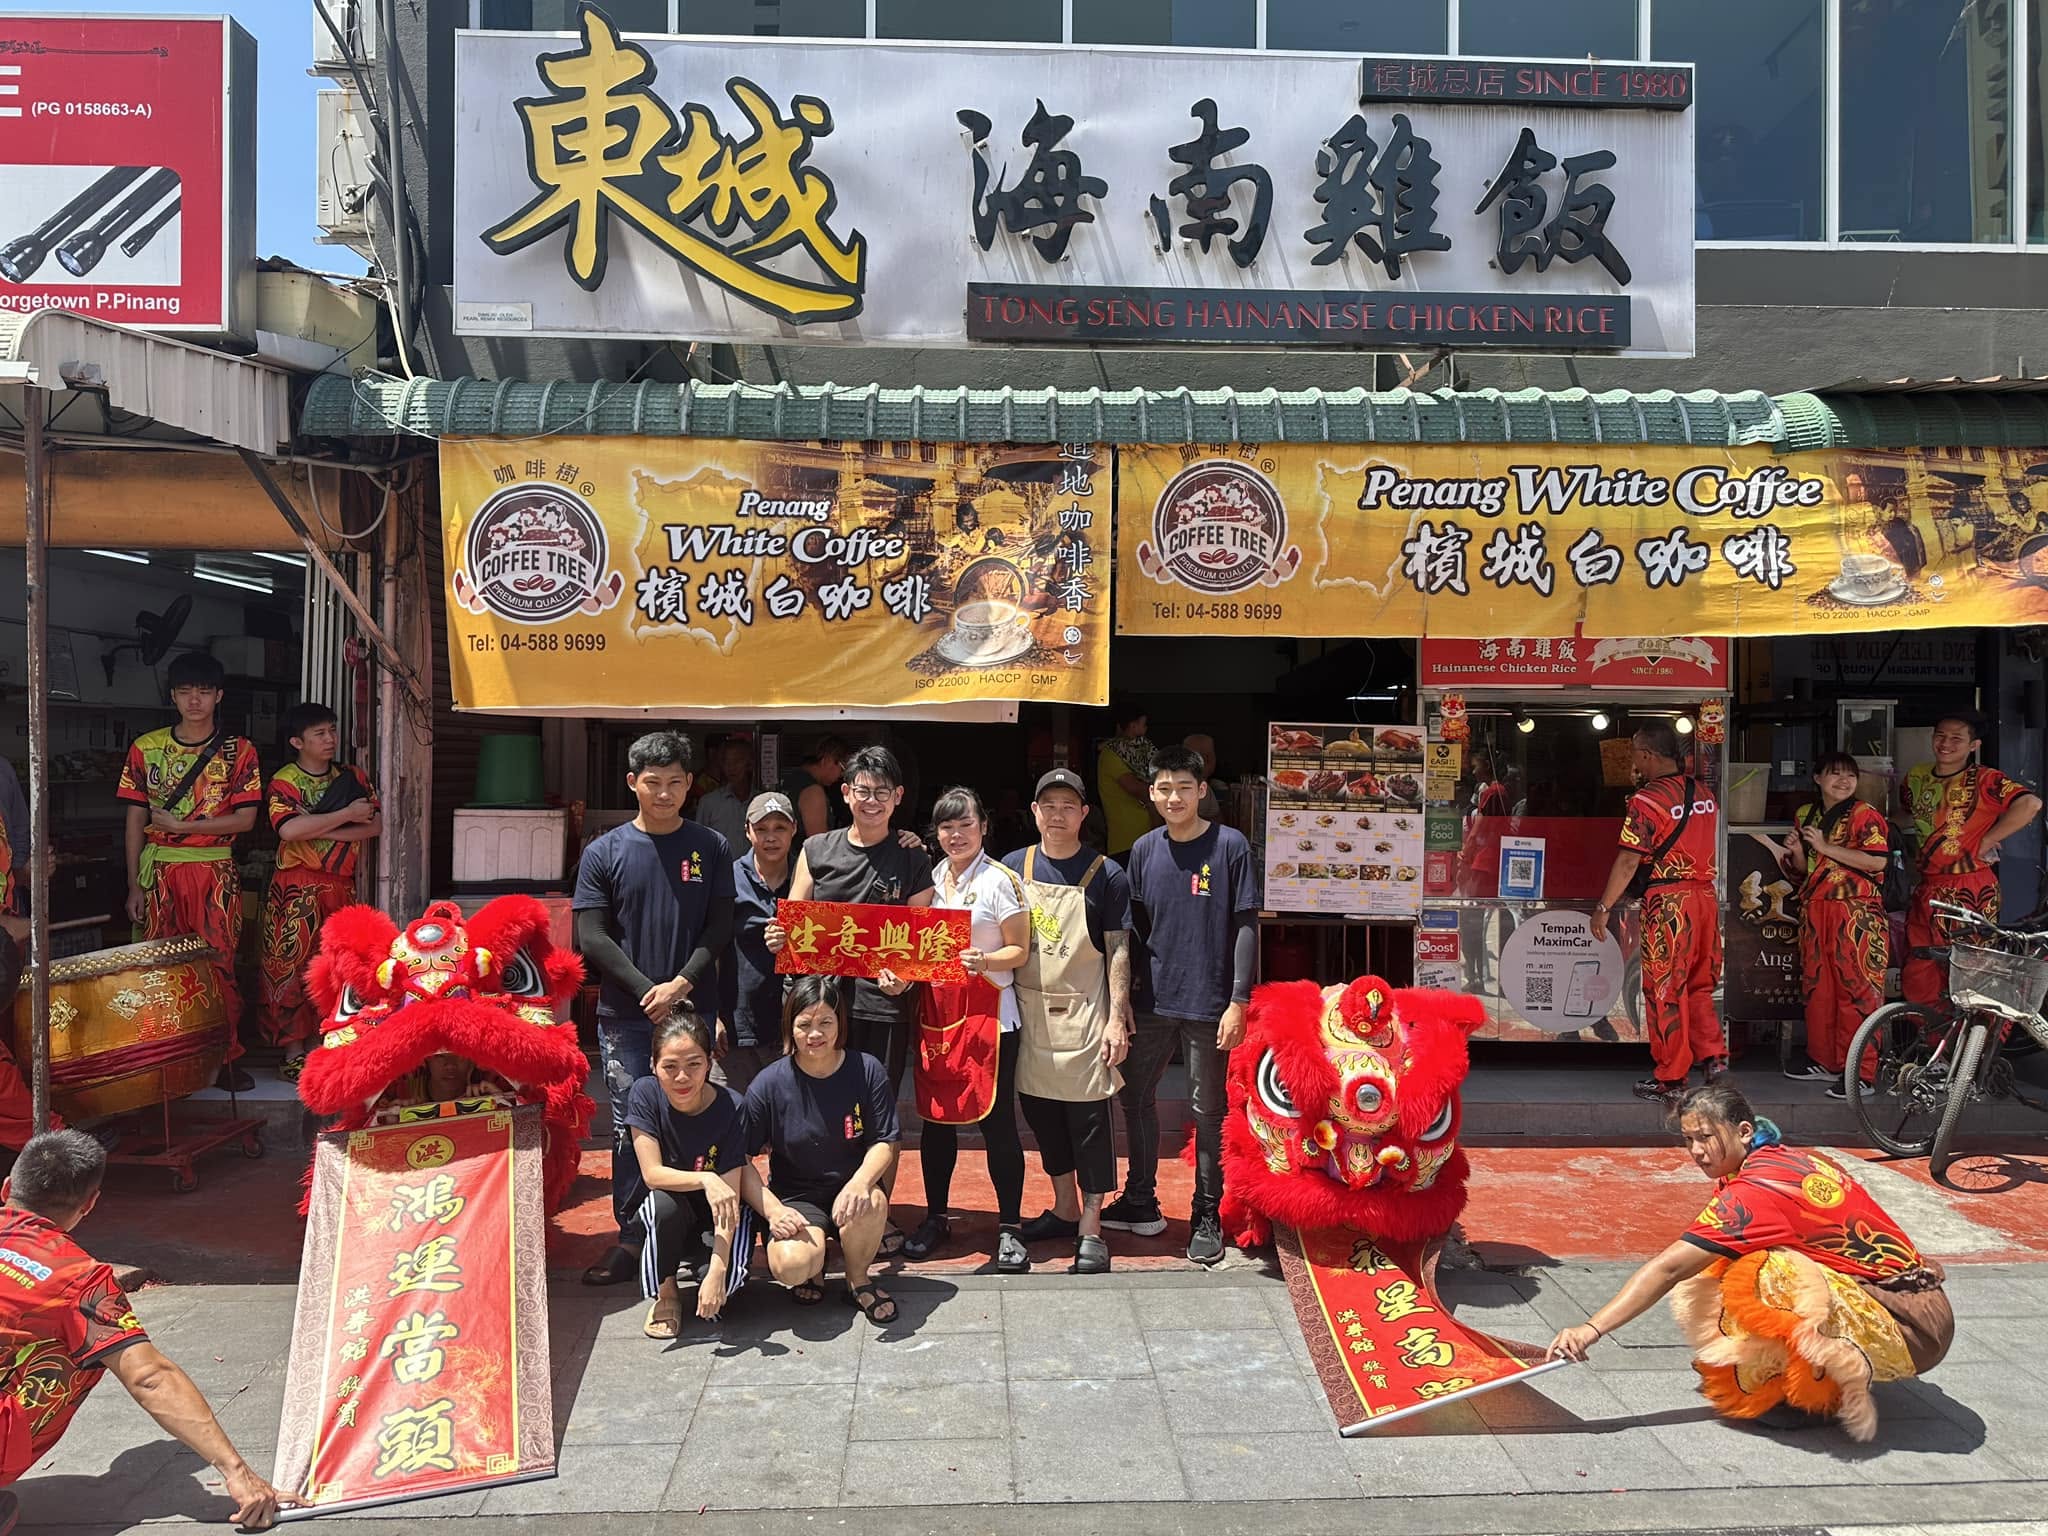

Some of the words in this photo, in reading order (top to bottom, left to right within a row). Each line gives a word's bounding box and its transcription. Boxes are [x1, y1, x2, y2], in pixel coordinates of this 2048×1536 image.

[1516, 69, 1607, 97] SINCE
[1616, 71, 1687, 98] 1980
[32, 101, 60, 117] (PG
[66, 103, 152, 119] 0158663-A)
[481, 2, 867, 324] 東城
[956, 97, 1633, 287] 海南雞飯
[97, 293, 181, 315] P.Pinang
[979, 296, 1081, 326] TONG
[1087, 298, 1176, 327] SENG
[1185, 300, 1377, 331] HAINANESE
[1386, 303, 1535, 333] CHICKEN
[1544, 306, 1615, 335] RICE
[493, 458, 580, 485] 咖啡樹
[1359, 466, 1507, 517] Penang
[1509, 466, 1668, 515] White
[1674, 466, 1824, 518] Coffee
[737, 490, 831, 521] Penang
[664, 524, 787, 563] White
[791, 525, 904, 566] Coffee
[1169, 525, 1225, 555] COFFEE
[1230, 526, 1267, 558] TREE
[482, 549, 540, 583] COFFEE
[546, 550, 587, 585] TREE
[1178, 555, 1217, 580] PREMIUM
[1219, 558, 1256, 580] QUALITY
[1402, 520, 1797, 597] 檳城白咖啡
[491, 583, 533, 609] PREMIUM
[535, 584, 575, 609] QUALITY
[635, 566, 934, 625] 檳城白咖啡
[1153, 602, 1180, 619] Tel:
[1186, 602, 1239, 619] 04-588
[1244, 603, 1283, 620] 9699
[1813, 612, 1831, 620] ISO
[1832, 610, 1860, 619] 22000
[1867, 610, 1901, 619] HACCP
[1908, 608, 1931, 617] GMP
[467, 634, 495, 652] Tel:
[500, 633, 559, 651] 04-588
[564, 633, 606, 651] 9699
[1478, 638, 1579, 663] 海南雞飯
[915, 678, 935, 689] ISO
[938, 675, 970, 688] 22000
[979, 673, 1022, 685] HACCP
[1031, 674, 1058, 686] GMP
[1432, 663, 1496, 673] Hainanese
[1499, 663, 1548, 673] Chicken
[1551, 664, 1577, 673] Rice
[1430, 831, 1454, 840] Food
[789, 915, 957, 963] 生意興隆
[1533, 936, 1593, 948] MaximCar
[1540, 923, 1586, 935] Tempah
[1754, 950, 1793, 970] Ang
[374, 1173, 466, 1481] 鴻運當頭
